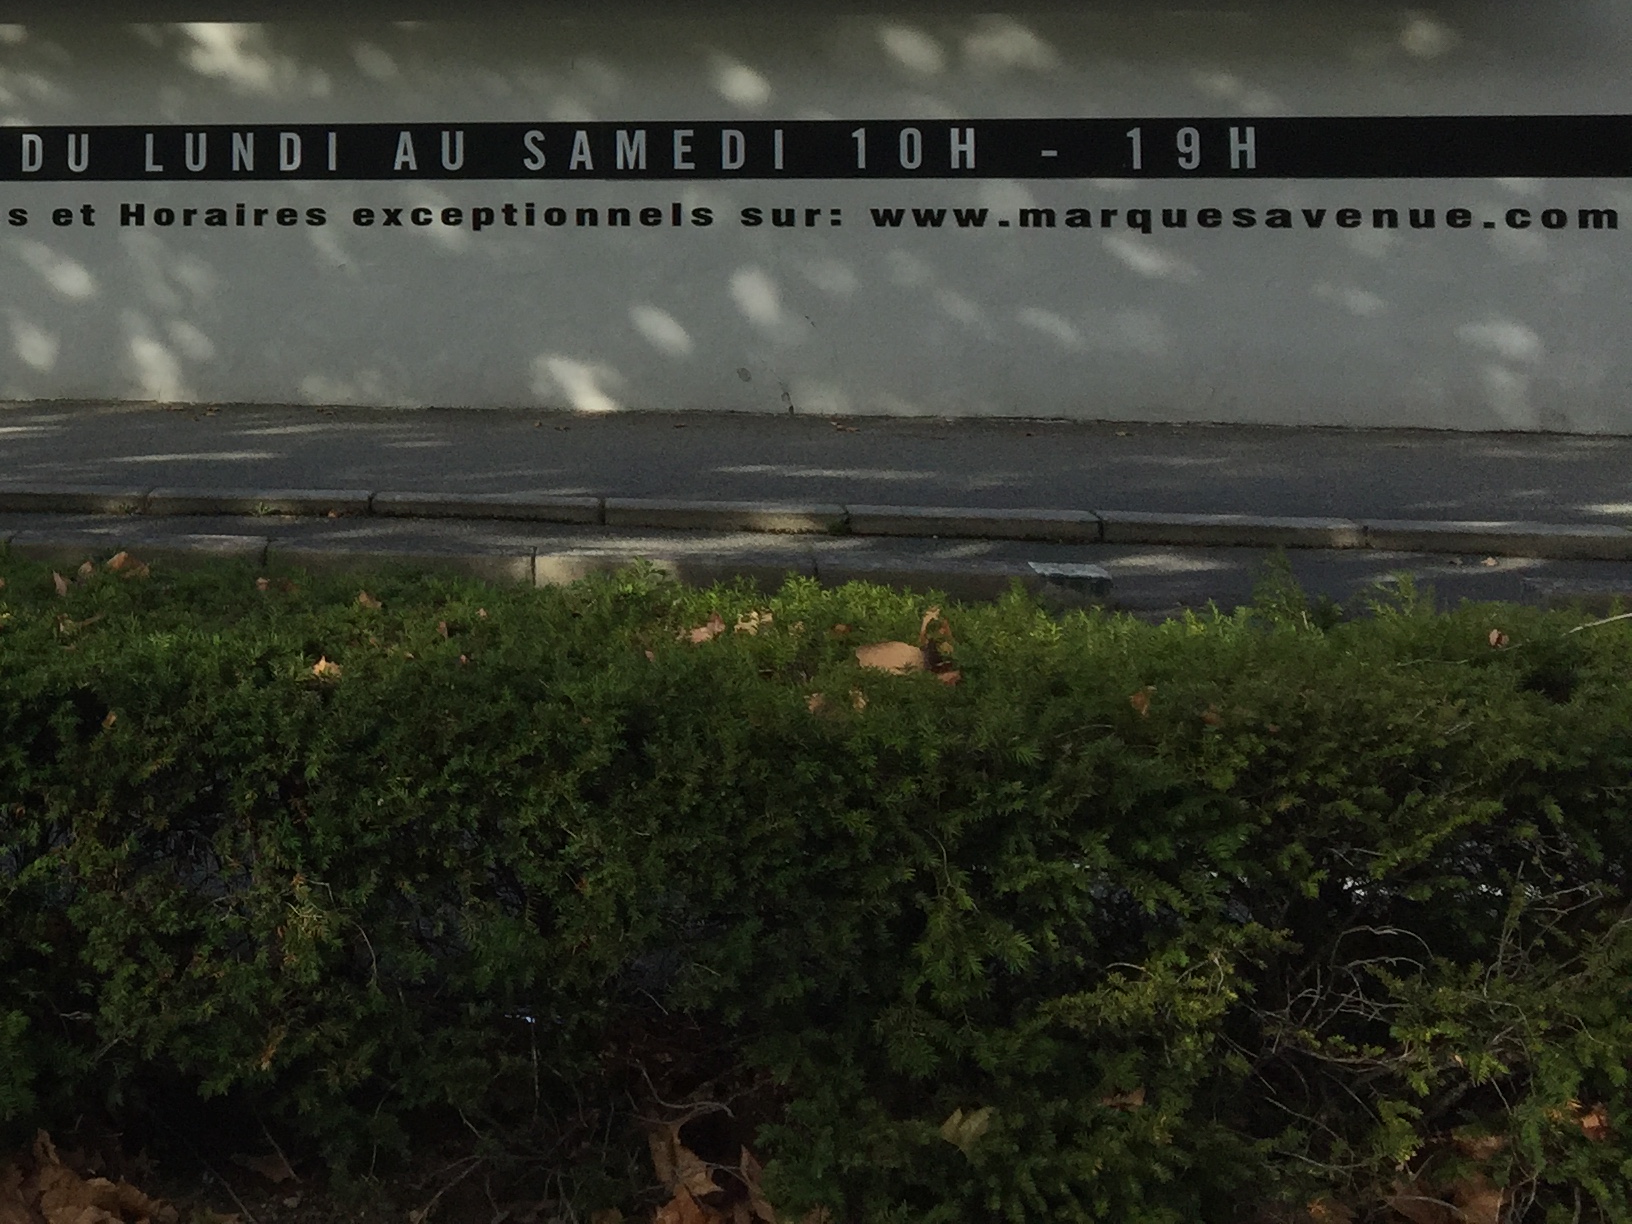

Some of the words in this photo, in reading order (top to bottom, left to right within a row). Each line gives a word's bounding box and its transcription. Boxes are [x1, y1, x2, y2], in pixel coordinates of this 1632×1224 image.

[21, 132, 90, 173] DU
[144, 131, 337, 173] LUNDI
[393, 129, 465, 172] AU
[522, 128, 785, 171] SAMEDI
[851, 127, 976, 170] 10H
[1125, 126, 1256, 170] 19H
[51, 203, 96, 227] et
[120, 203, 327, 227] Horaires
[352, 202, 714, 232] exceptionnels
[740, 206, 843, 228] sur:
[869, 206, 1620, 235] www.marquesavenue.com
